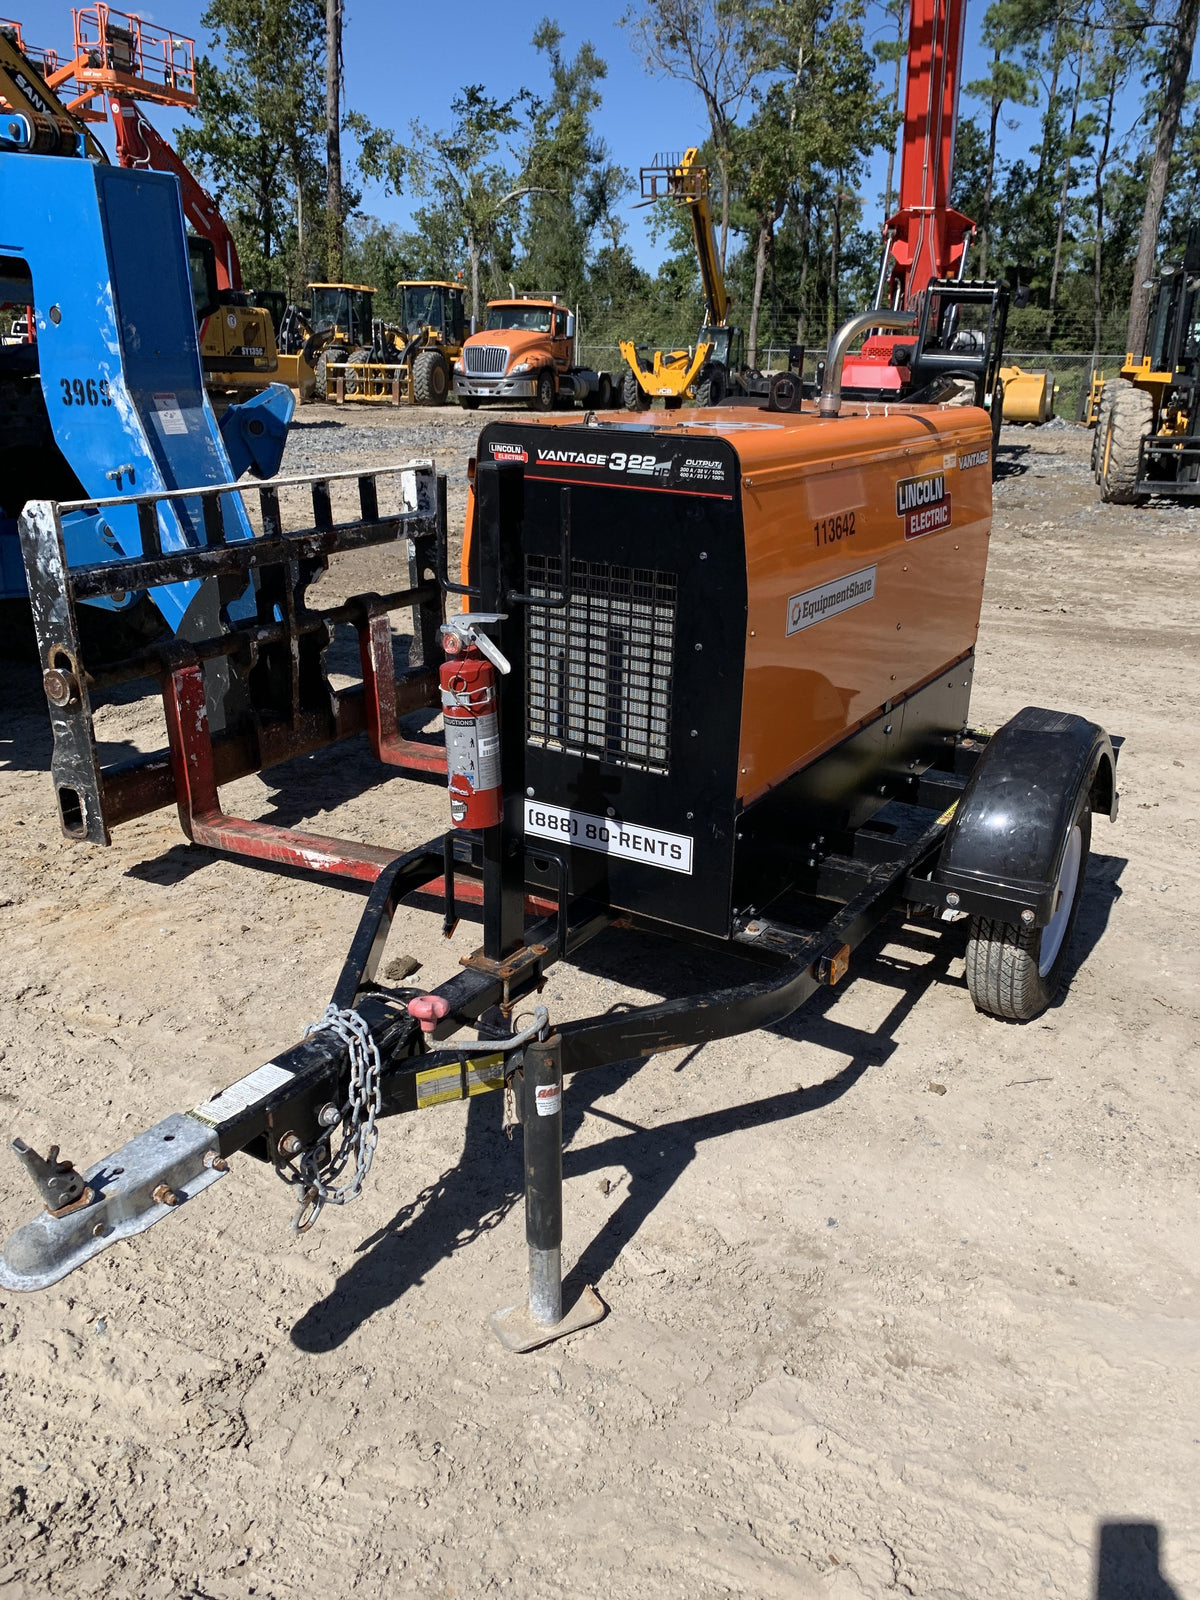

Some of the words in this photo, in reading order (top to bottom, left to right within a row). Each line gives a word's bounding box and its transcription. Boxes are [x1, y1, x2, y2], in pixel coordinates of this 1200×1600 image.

[60, 378, 112, 407] 3969
[491, 444, 520, 454] LINCOLN
[498, 453, 525, 461] ELECTRIC
[537, 449, 607, 465] VANTAGE
[608, 452, 656, 471] 322
[685, 459, 720, 467] OUTPUT
[959, 450, 989, 470] VANTAGE
[899, 477, 943, 511] LINCOLN
[814, 512, 856, 547] 113642
[910, 505, 948, 533] ELECTRIC
[801, 579, 872, 619] EquipmentShare
[528, 809, 578, 836] (888)
[585, 824, 682, 860] 80-RENTS
